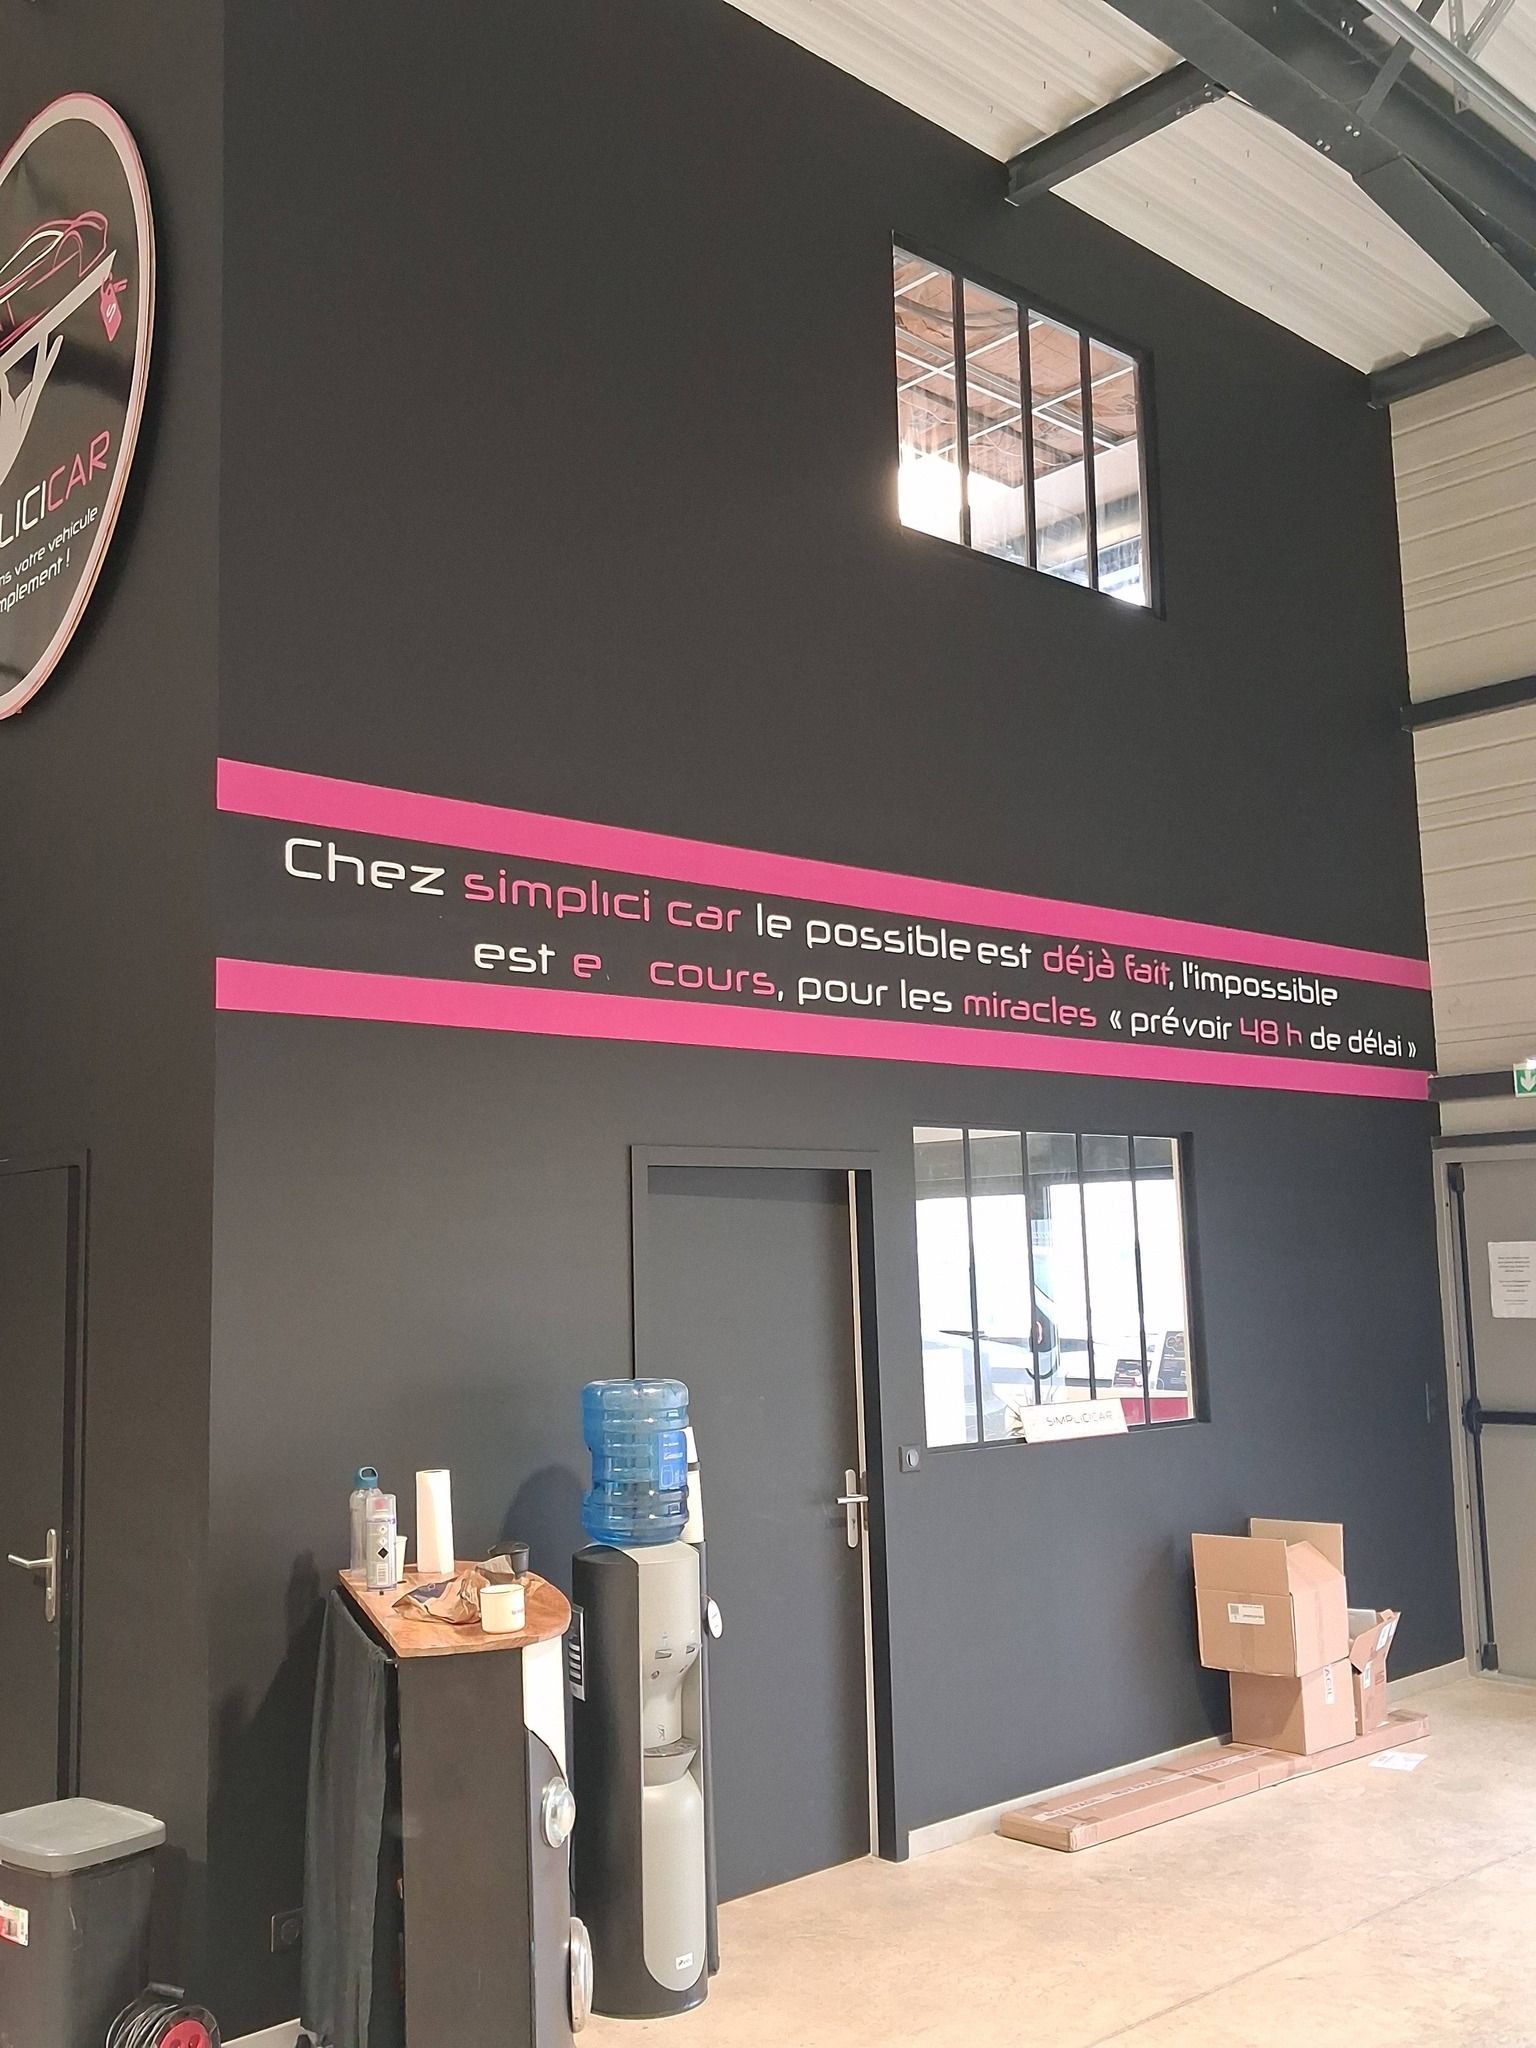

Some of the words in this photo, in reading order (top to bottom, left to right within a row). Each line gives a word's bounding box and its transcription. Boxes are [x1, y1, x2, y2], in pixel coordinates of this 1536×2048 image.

[14, 546, 46, 576] votre
[284, 837, 446, 896] Chez
[667, 900, 742, 933] car
[756, 902, 792, 939] le
[806, 919, 972, 961] possible
[977, 942, 1033, 969] est
[1042, 943, 1115, 983] déjà
[1124, 951, 1174, 991] fait,
[1182, 960, 1338, 1006] l'impossible
[473, 943, 556, 975] est
[649, 960, 784, 1002] cours,
[797, 976, 889, 1007] pour
[900, 978, 953, 1013] les
[963, 991, 1098, 1028] miracles
[1130, 1006, 1233, 1041] prévoir
[1239, 1017, 1280, 1045] 48
[1286, 1021, 1303, 1047] h
[1309, 1025, 1342, 1051] de
[1348, 1028, 1402, 1057] délai
